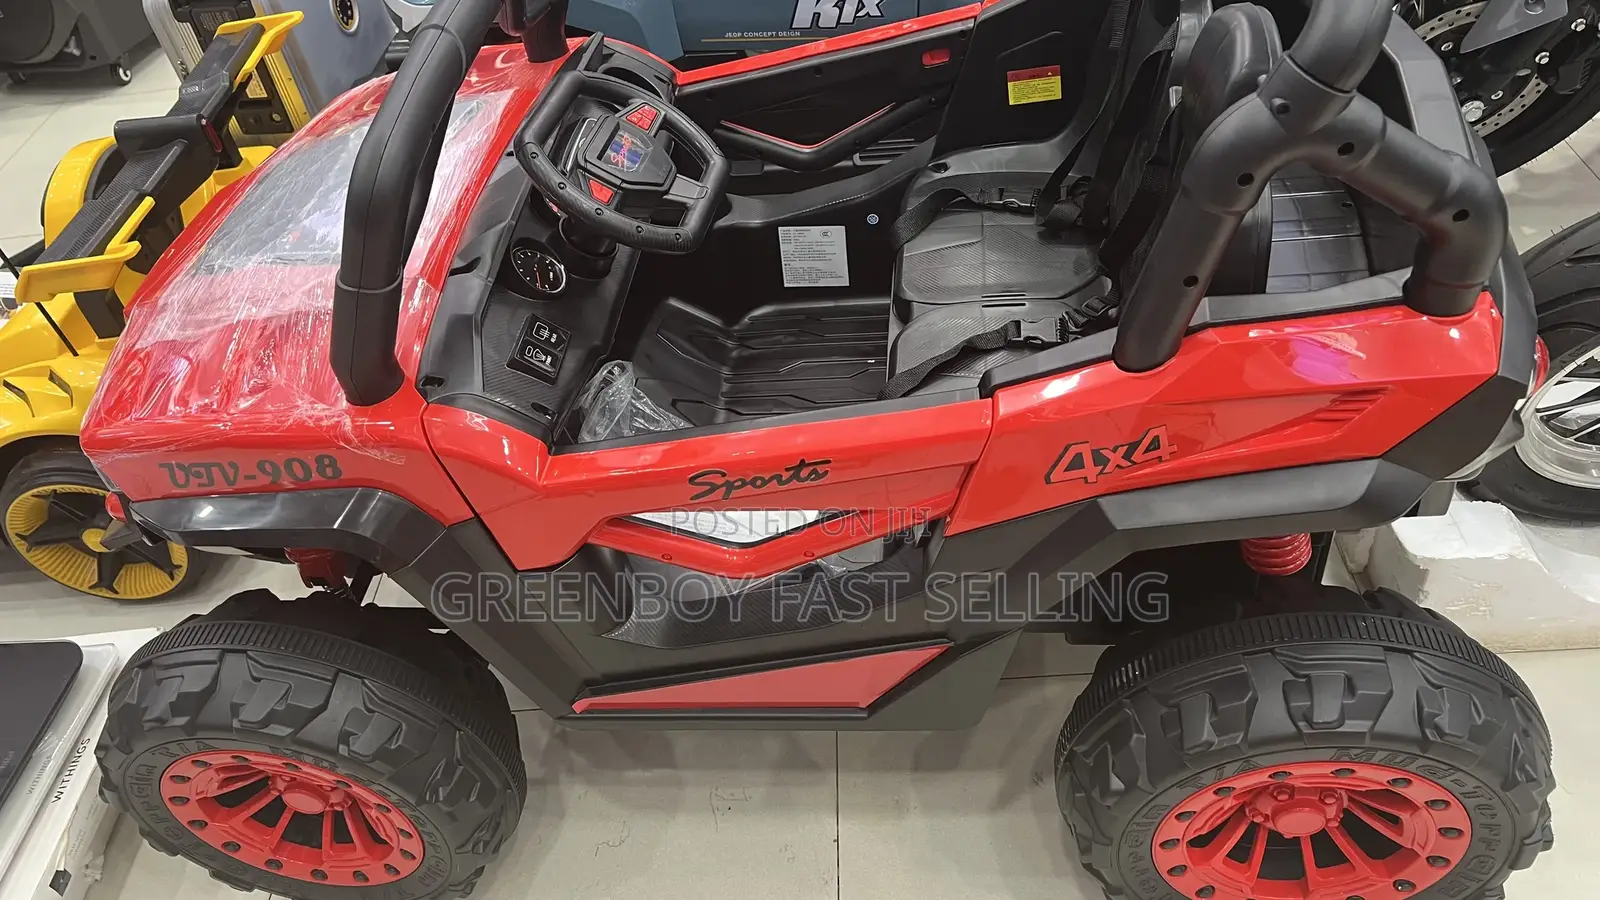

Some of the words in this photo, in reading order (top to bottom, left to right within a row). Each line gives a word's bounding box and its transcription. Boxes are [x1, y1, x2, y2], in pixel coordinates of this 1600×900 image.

[687, 458, 832, 501] Sports
[1044, 424, 1177, 485] 4x4
[52, 737, 91, 804] WITHINGS
